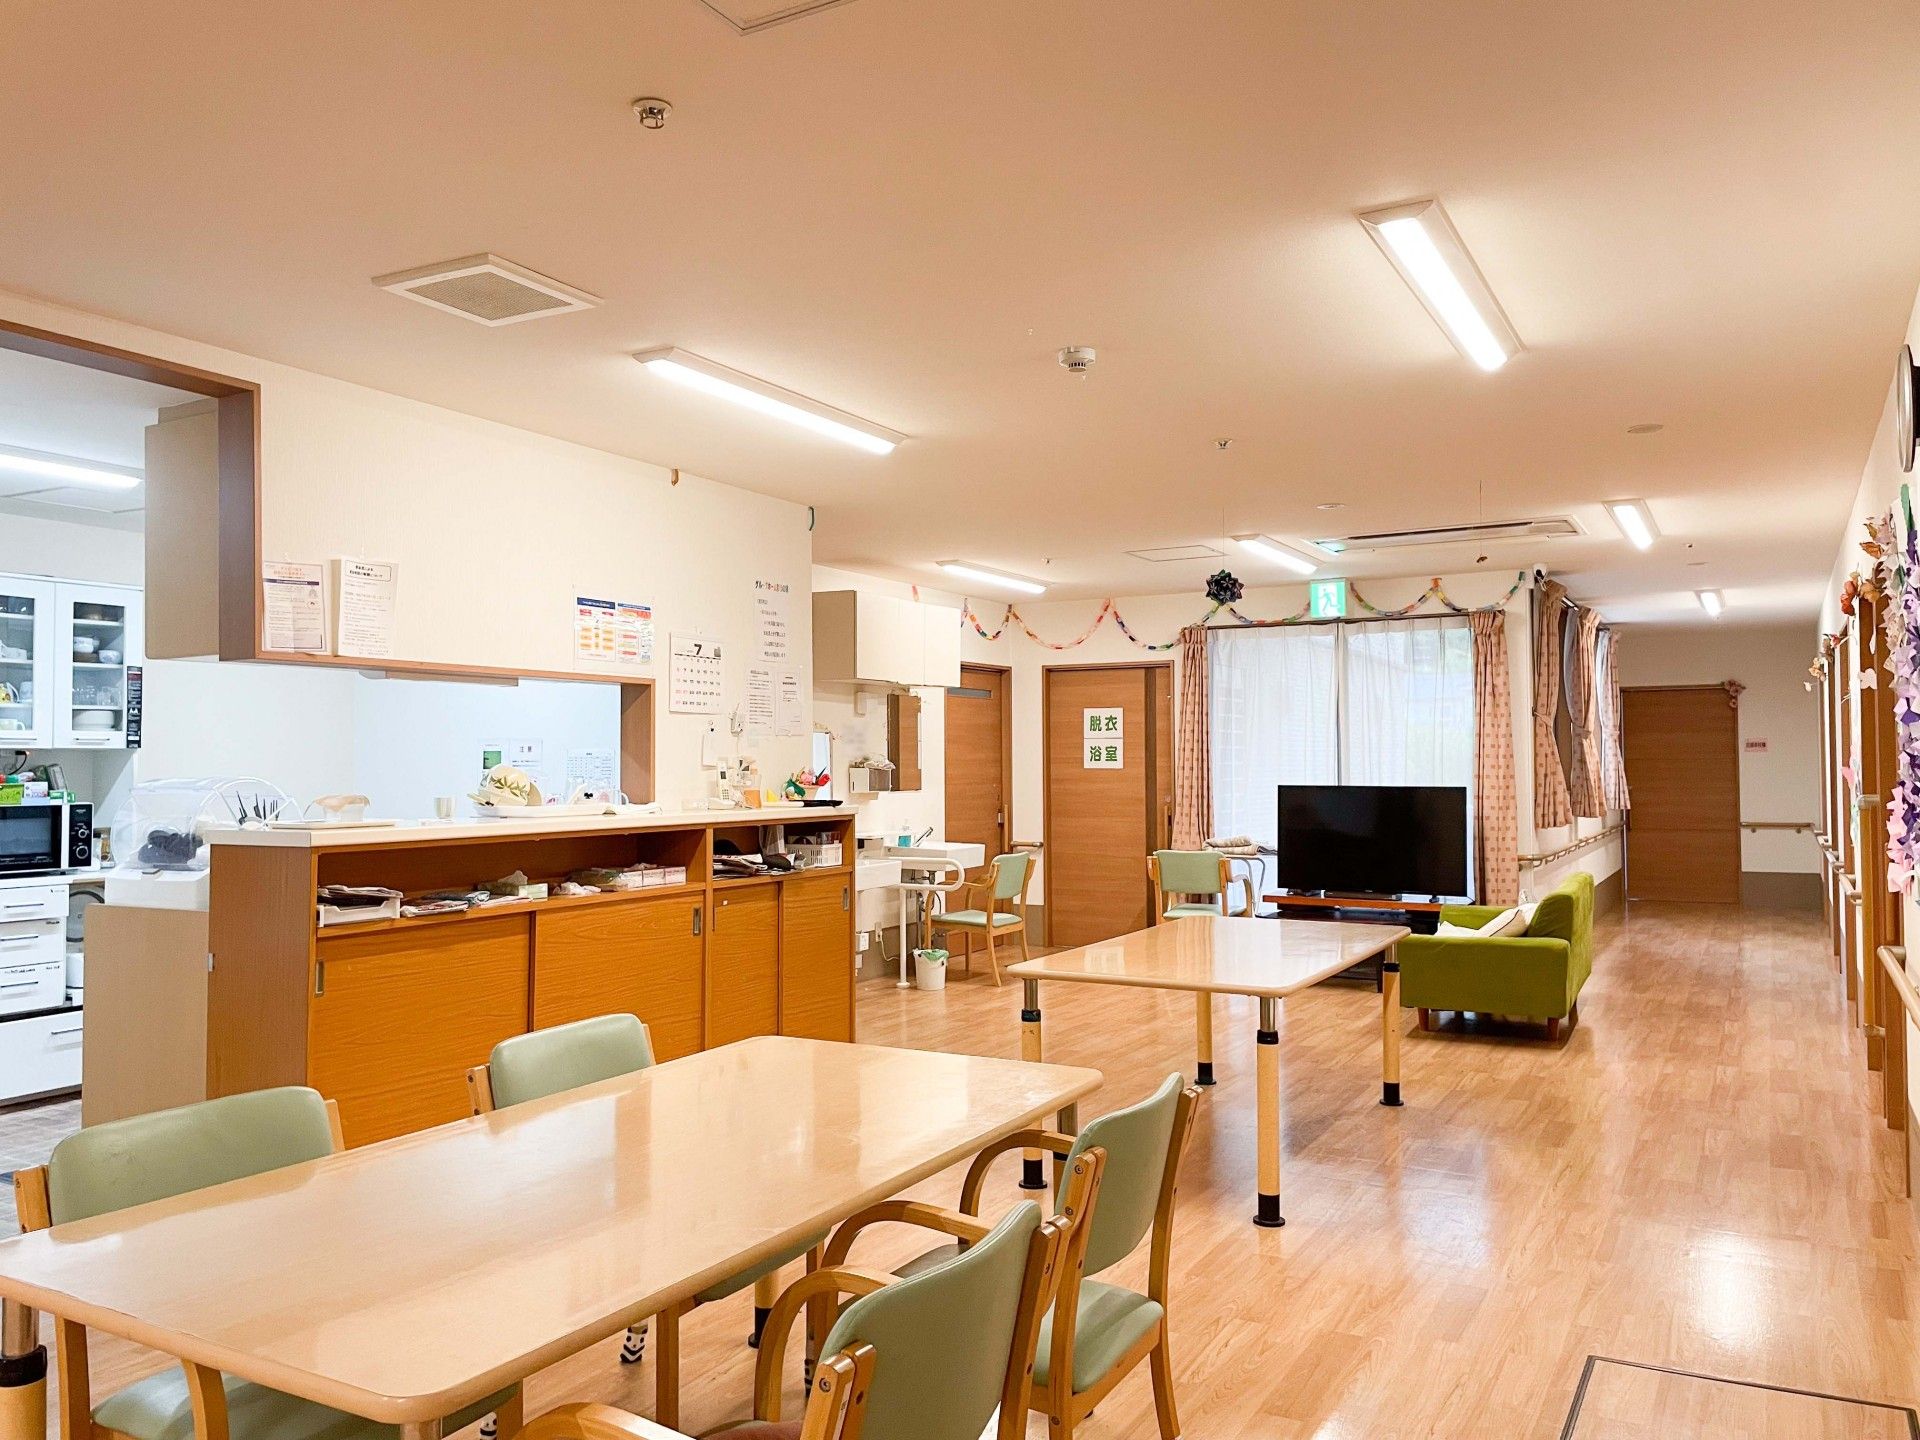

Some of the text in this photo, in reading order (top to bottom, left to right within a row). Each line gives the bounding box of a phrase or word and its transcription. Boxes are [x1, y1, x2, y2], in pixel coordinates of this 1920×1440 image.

[694, 643, 702, 656] 7
[1090, 715, 1117, 731] 脱衣
[1090, 745, 1118, 762] 浴室
